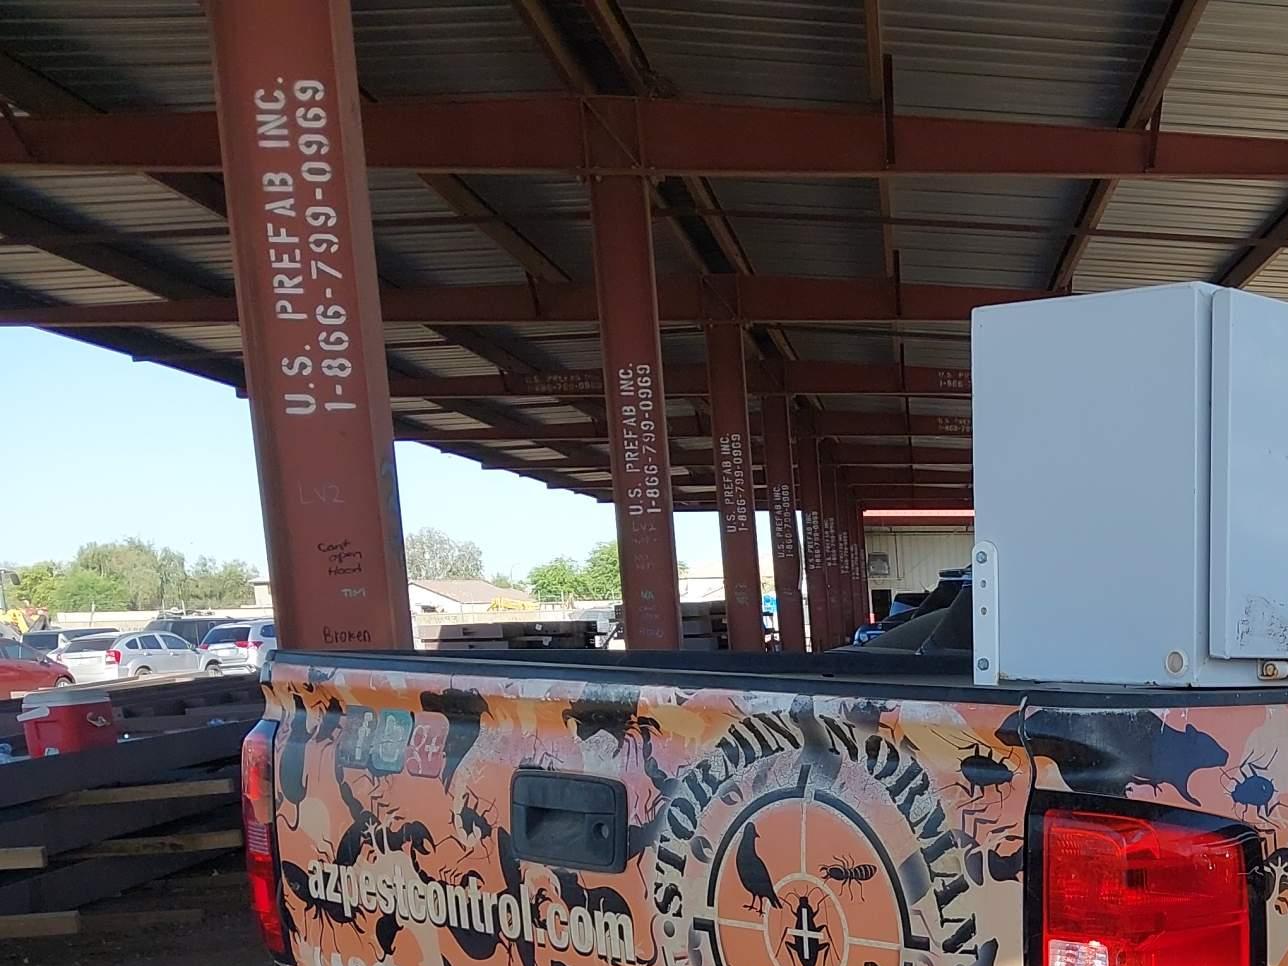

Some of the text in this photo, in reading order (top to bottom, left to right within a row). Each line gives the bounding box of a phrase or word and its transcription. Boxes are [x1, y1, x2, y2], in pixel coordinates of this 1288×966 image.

[254, 76, 317, 415] U.S. PREFAB INC.
[293, 79, 357, 411] 1-866-799-0969
[618, 362, 644, 516] U.S. PREFAB INC.
[636, 364, 662, 513] 1-866-799-0969
[722, 460, 734, 505] PREFAB
[308, 859, 638, 966] azpestcontrol.com
[819, 713, 979, 960] NORMAN
